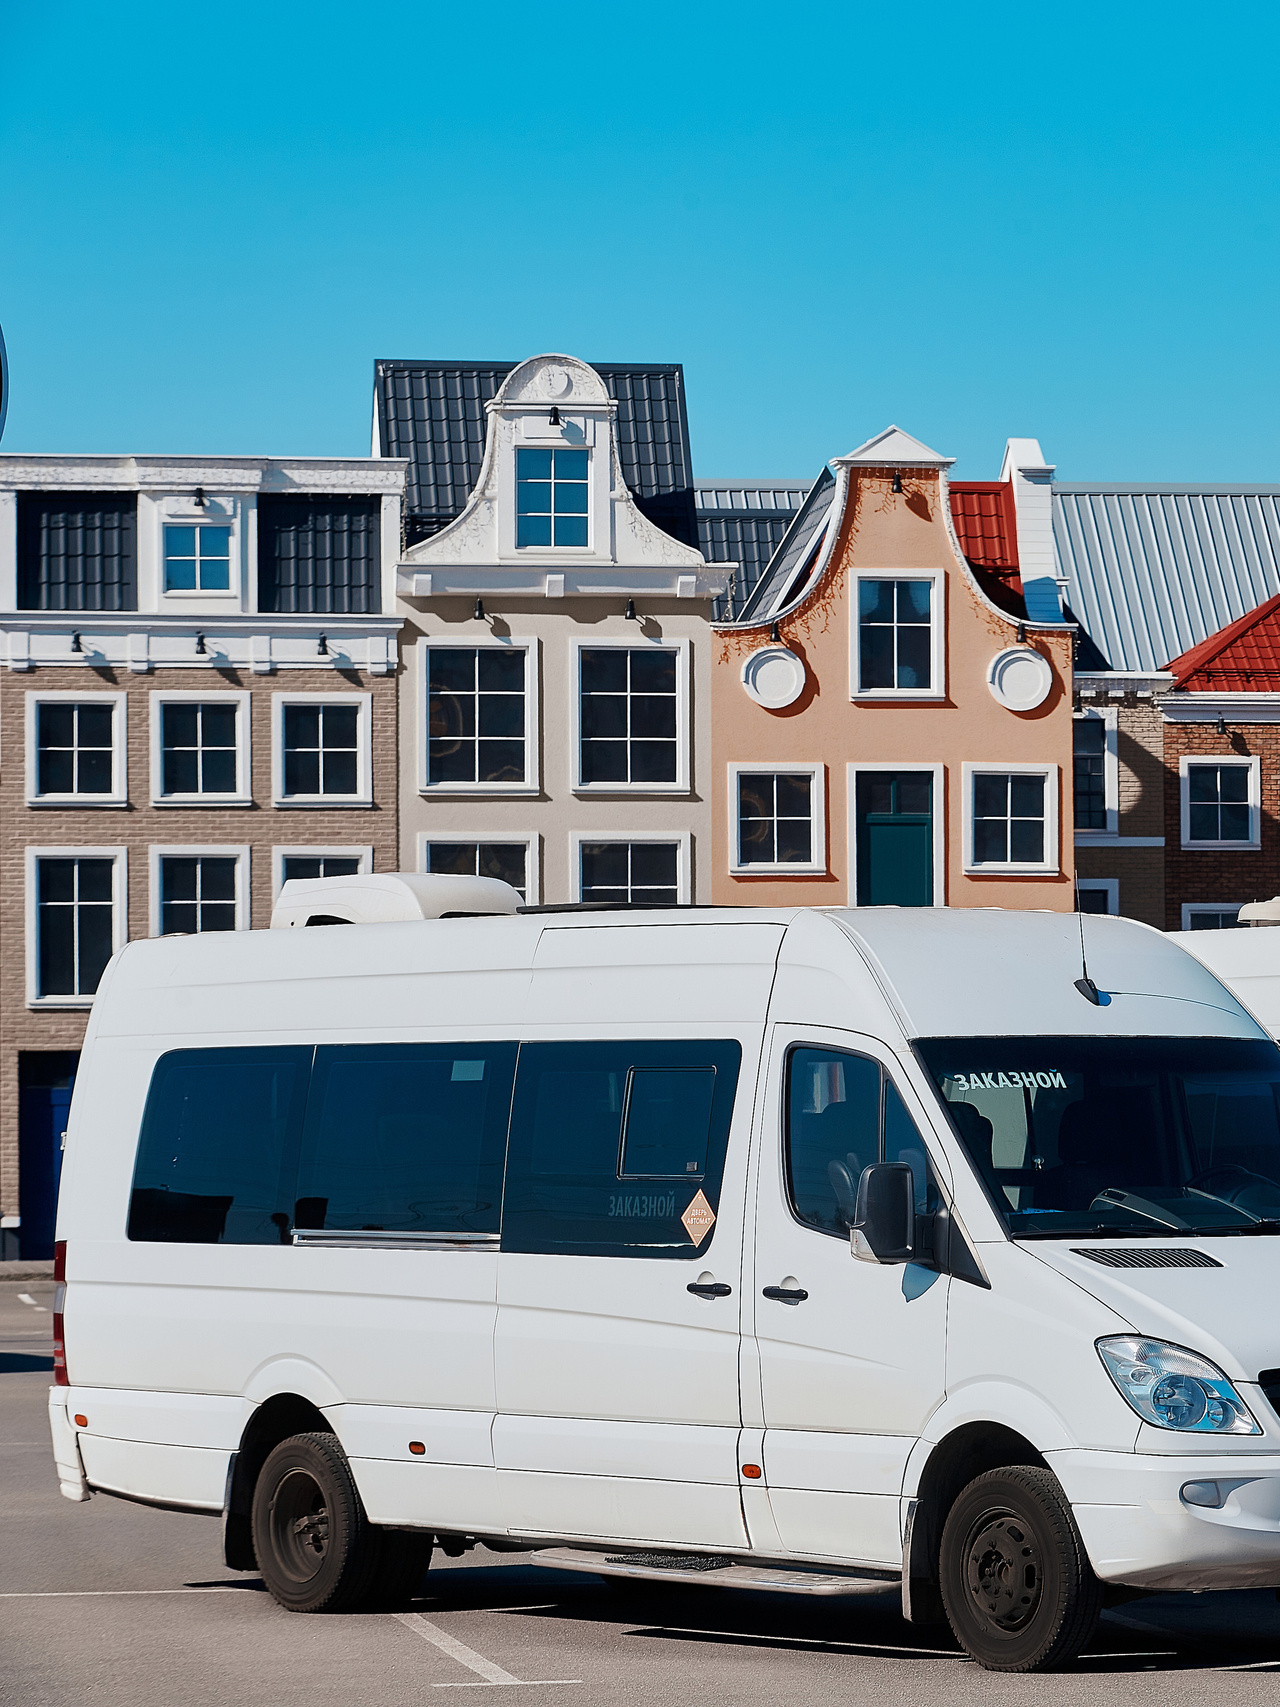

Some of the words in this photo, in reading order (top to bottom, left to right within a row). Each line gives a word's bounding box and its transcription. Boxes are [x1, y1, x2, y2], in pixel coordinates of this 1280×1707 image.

[953, 1068, 1067, 1091] ЗАКАЗНОЙ
[608, 1190, 675, 1217] ЗАКАЗНОЙ
[686, 1217, 711, 1225] АВТОМАТ
